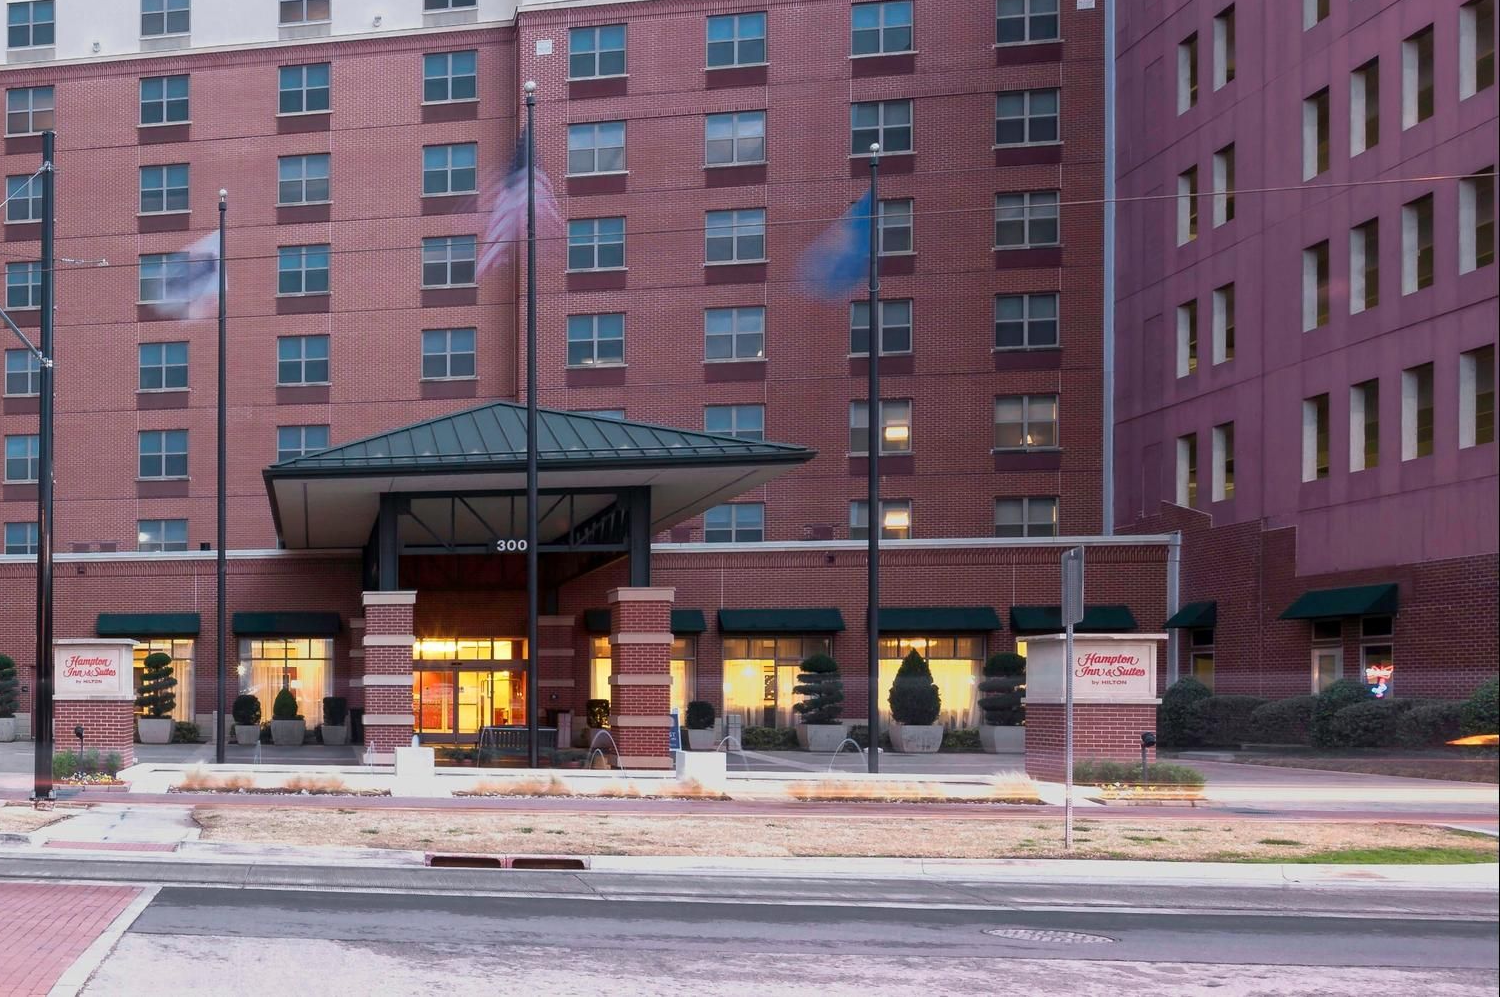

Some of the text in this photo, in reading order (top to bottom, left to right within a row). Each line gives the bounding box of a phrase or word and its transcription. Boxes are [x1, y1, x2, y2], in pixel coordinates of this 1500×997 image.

[497, 539, 528, 551] 300
[65, 655, 112, 668] Hampton
[1077, 652, 1140, 667] Hampton
[63, 667, 116, 677] Inn & Suites
[1075, 666, 1145, 678] Inn & Suites
